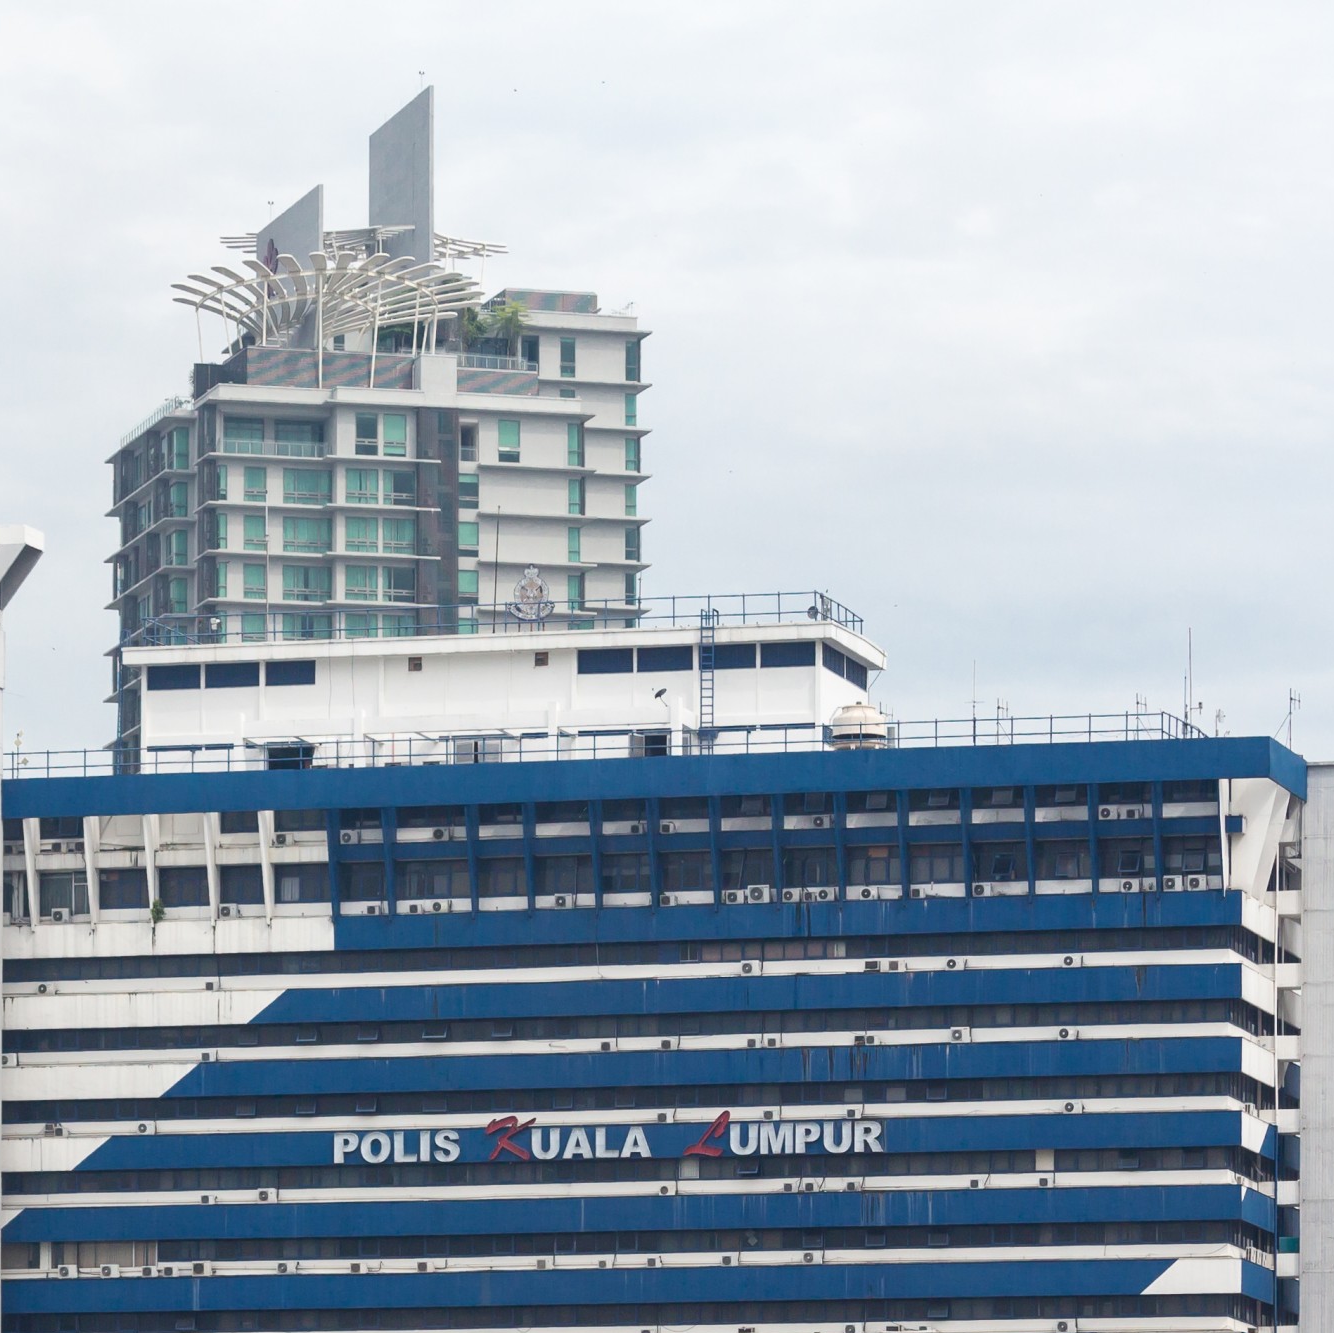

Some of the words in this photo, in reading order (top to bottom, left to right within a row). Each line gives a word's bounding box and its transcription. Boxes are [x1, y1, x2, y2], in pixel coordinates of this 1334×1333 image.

[333, 1129, 461, 1164] POLIS
[485, 1115, 652, 1160] KUALA
[683, 1110, 884, 1157] LUMPUR
